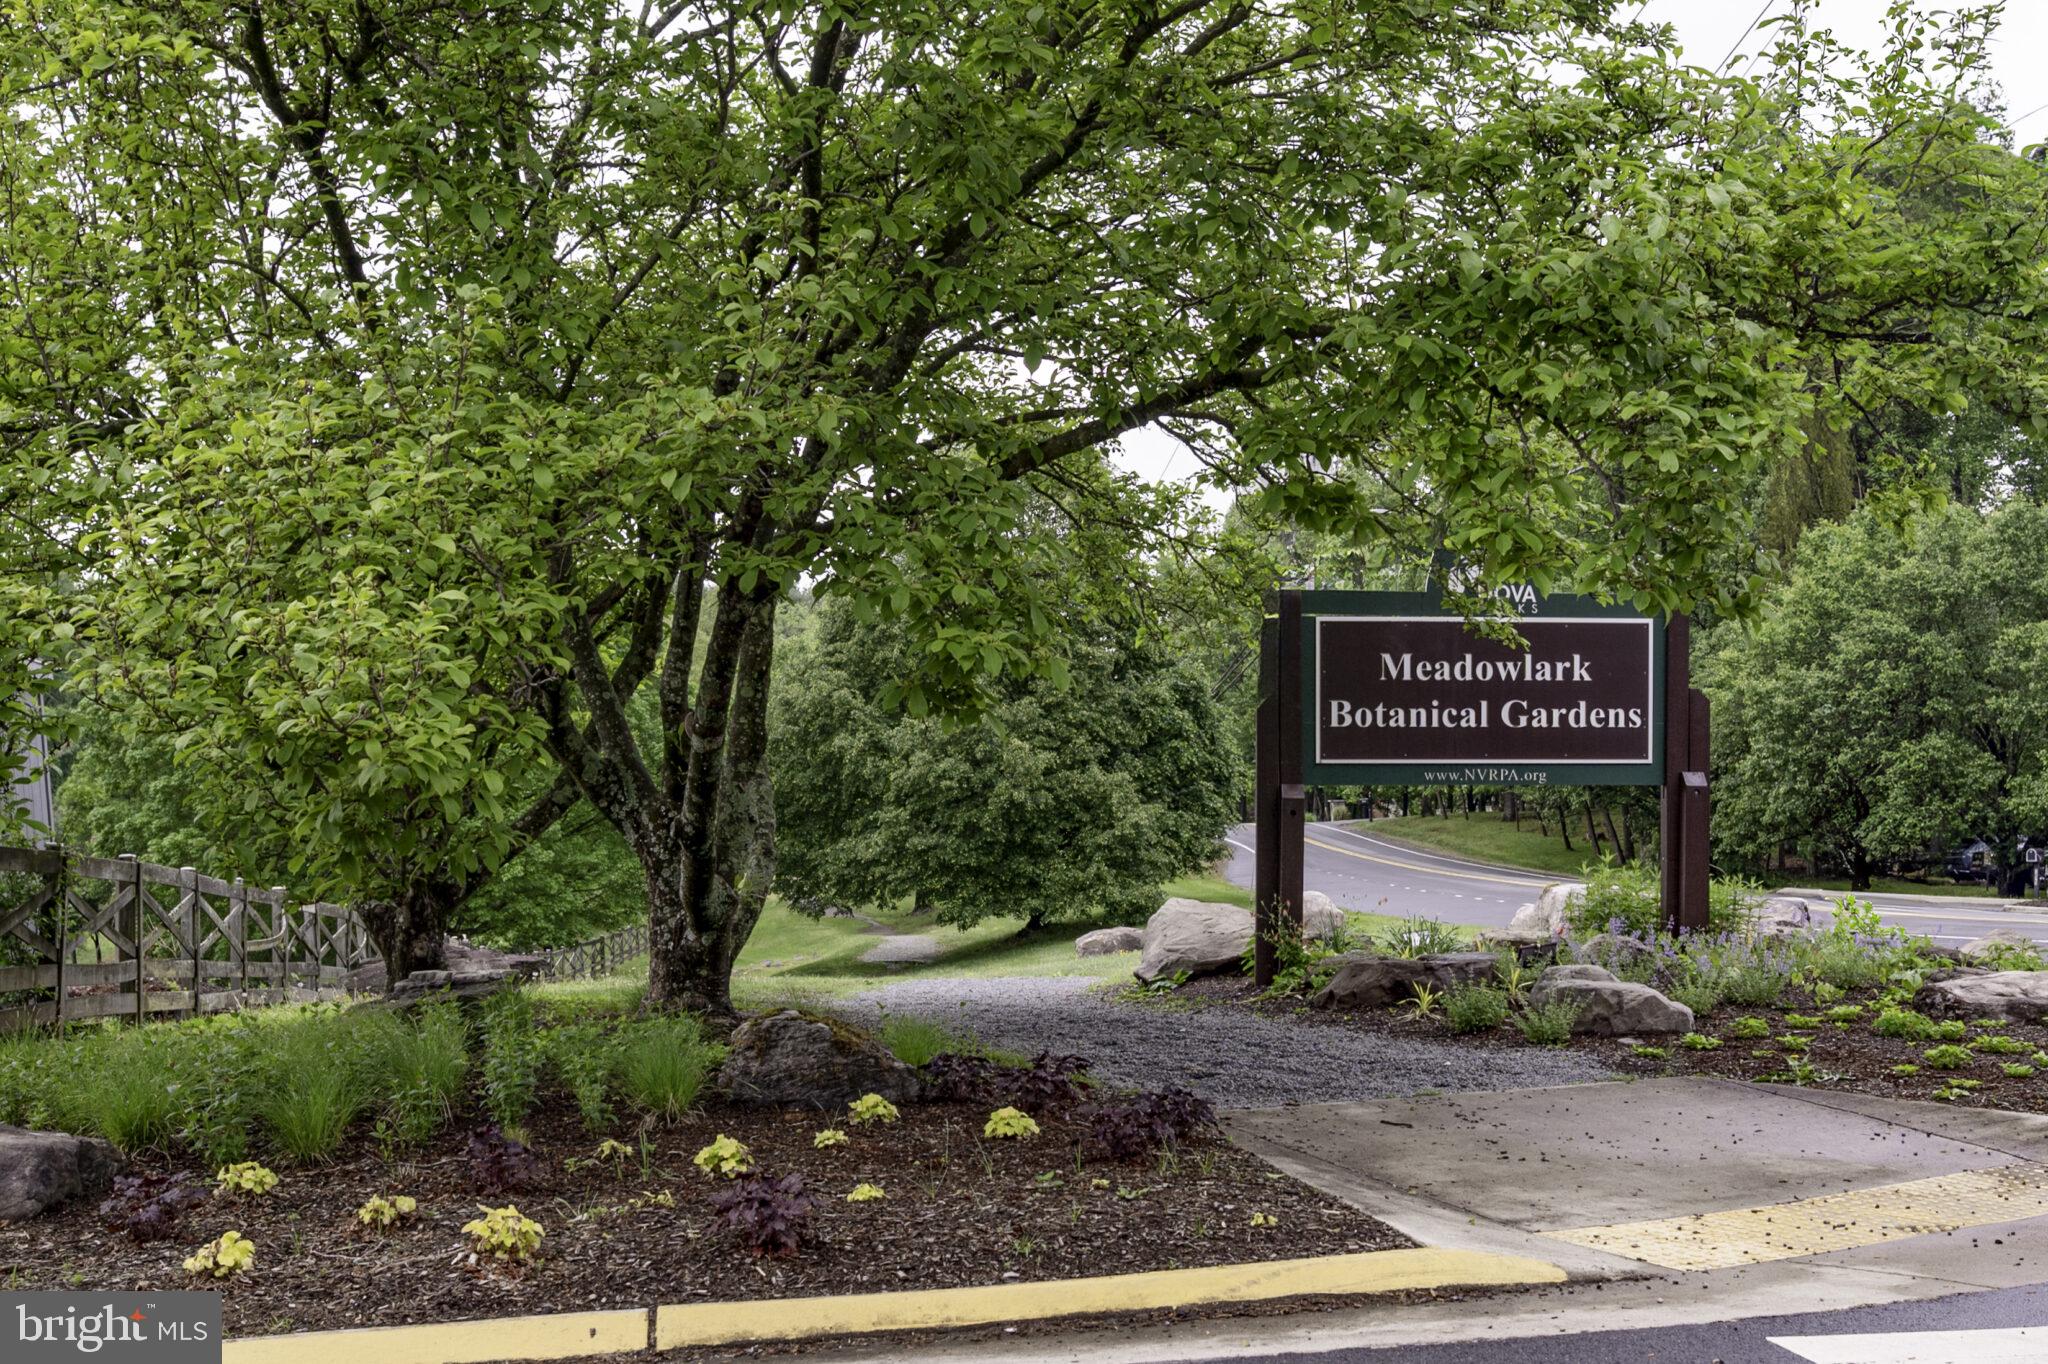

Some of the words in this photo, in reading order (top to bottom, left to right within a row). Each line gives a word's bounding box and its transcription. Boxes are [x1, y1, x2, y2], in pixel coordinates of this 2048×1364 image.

[1480, 584, 1537, 603] OVA
[1380, 653, 1592, 682] Meadowlark
[1330, 699, 1488, 728] Botanical
[1501, 699, 1642, 728] Gardens
[1424, 765, 1547, 784] www.NVRPA.org
